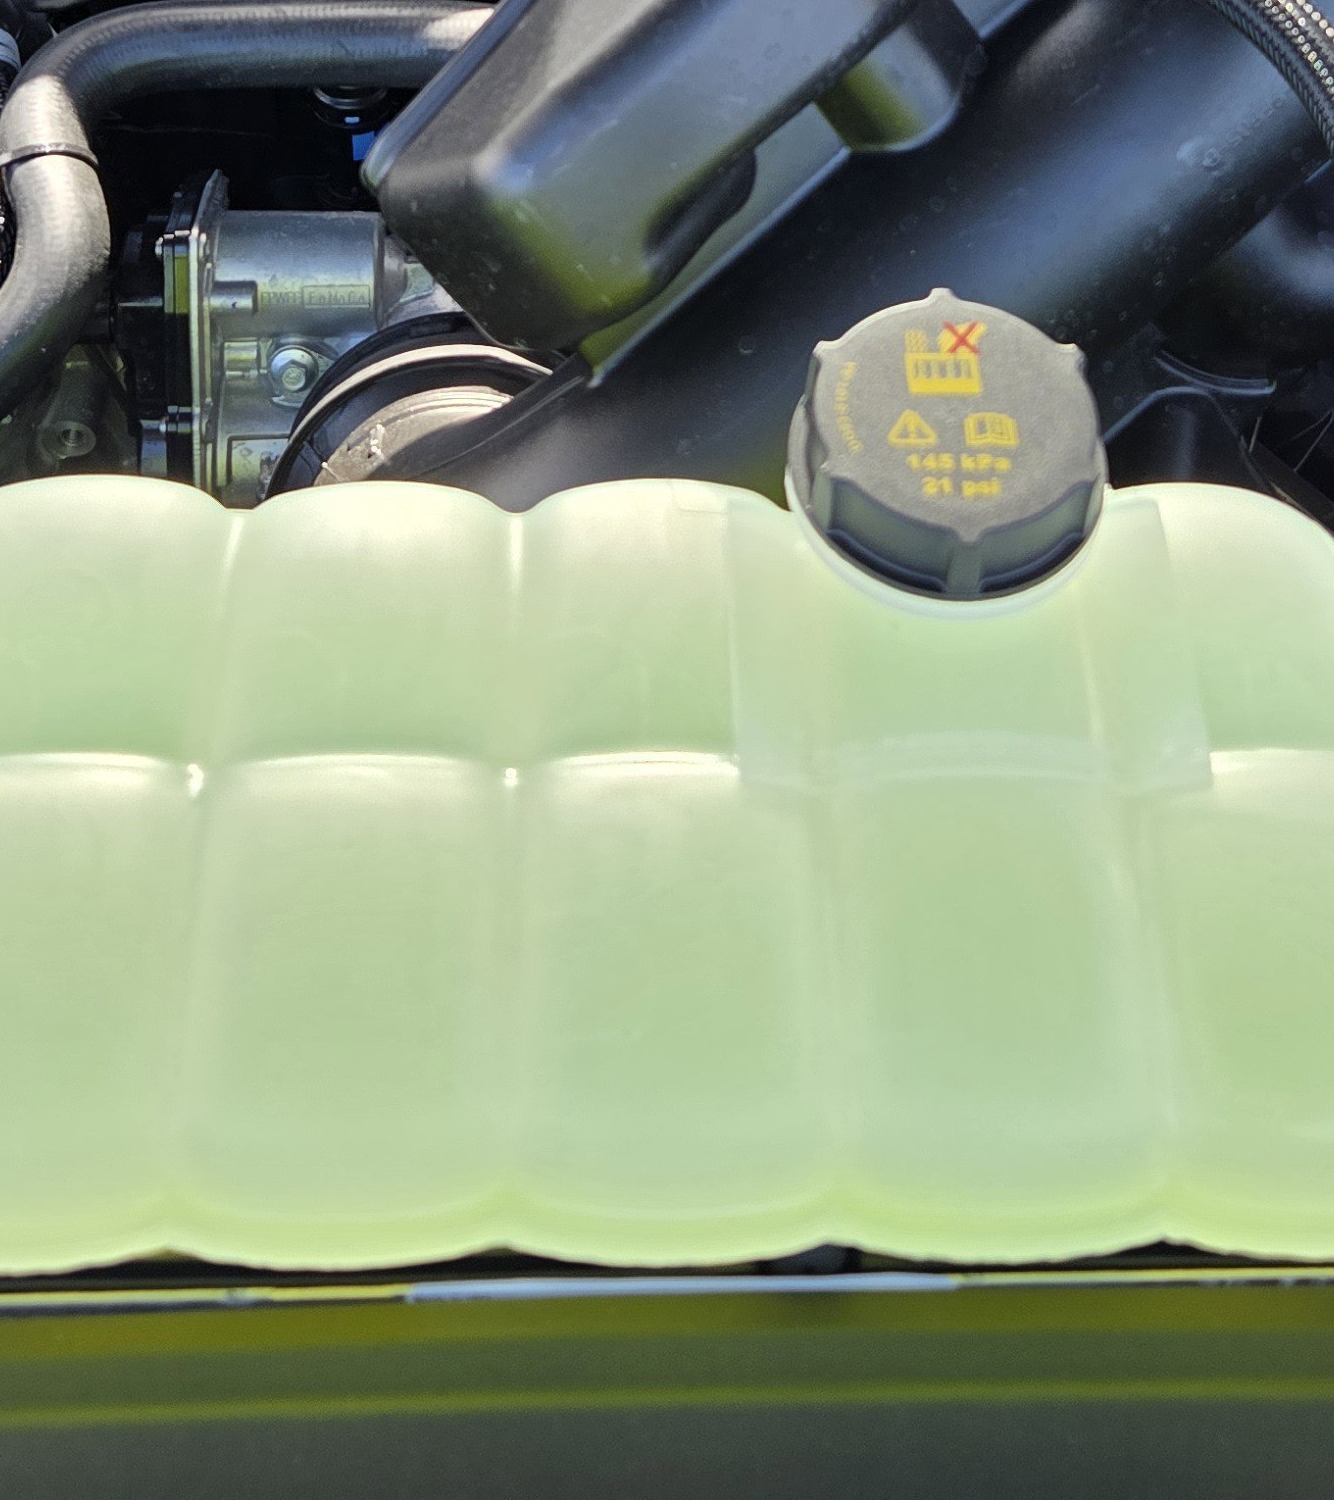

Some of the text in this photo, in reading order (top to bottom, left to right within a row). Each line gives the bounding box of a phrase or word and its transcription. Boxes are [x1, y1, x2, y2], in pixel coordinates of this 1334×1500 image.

[907, 452, 1012, 472] 145 kPa
[922, 477, 1002, 499] 21 psi
